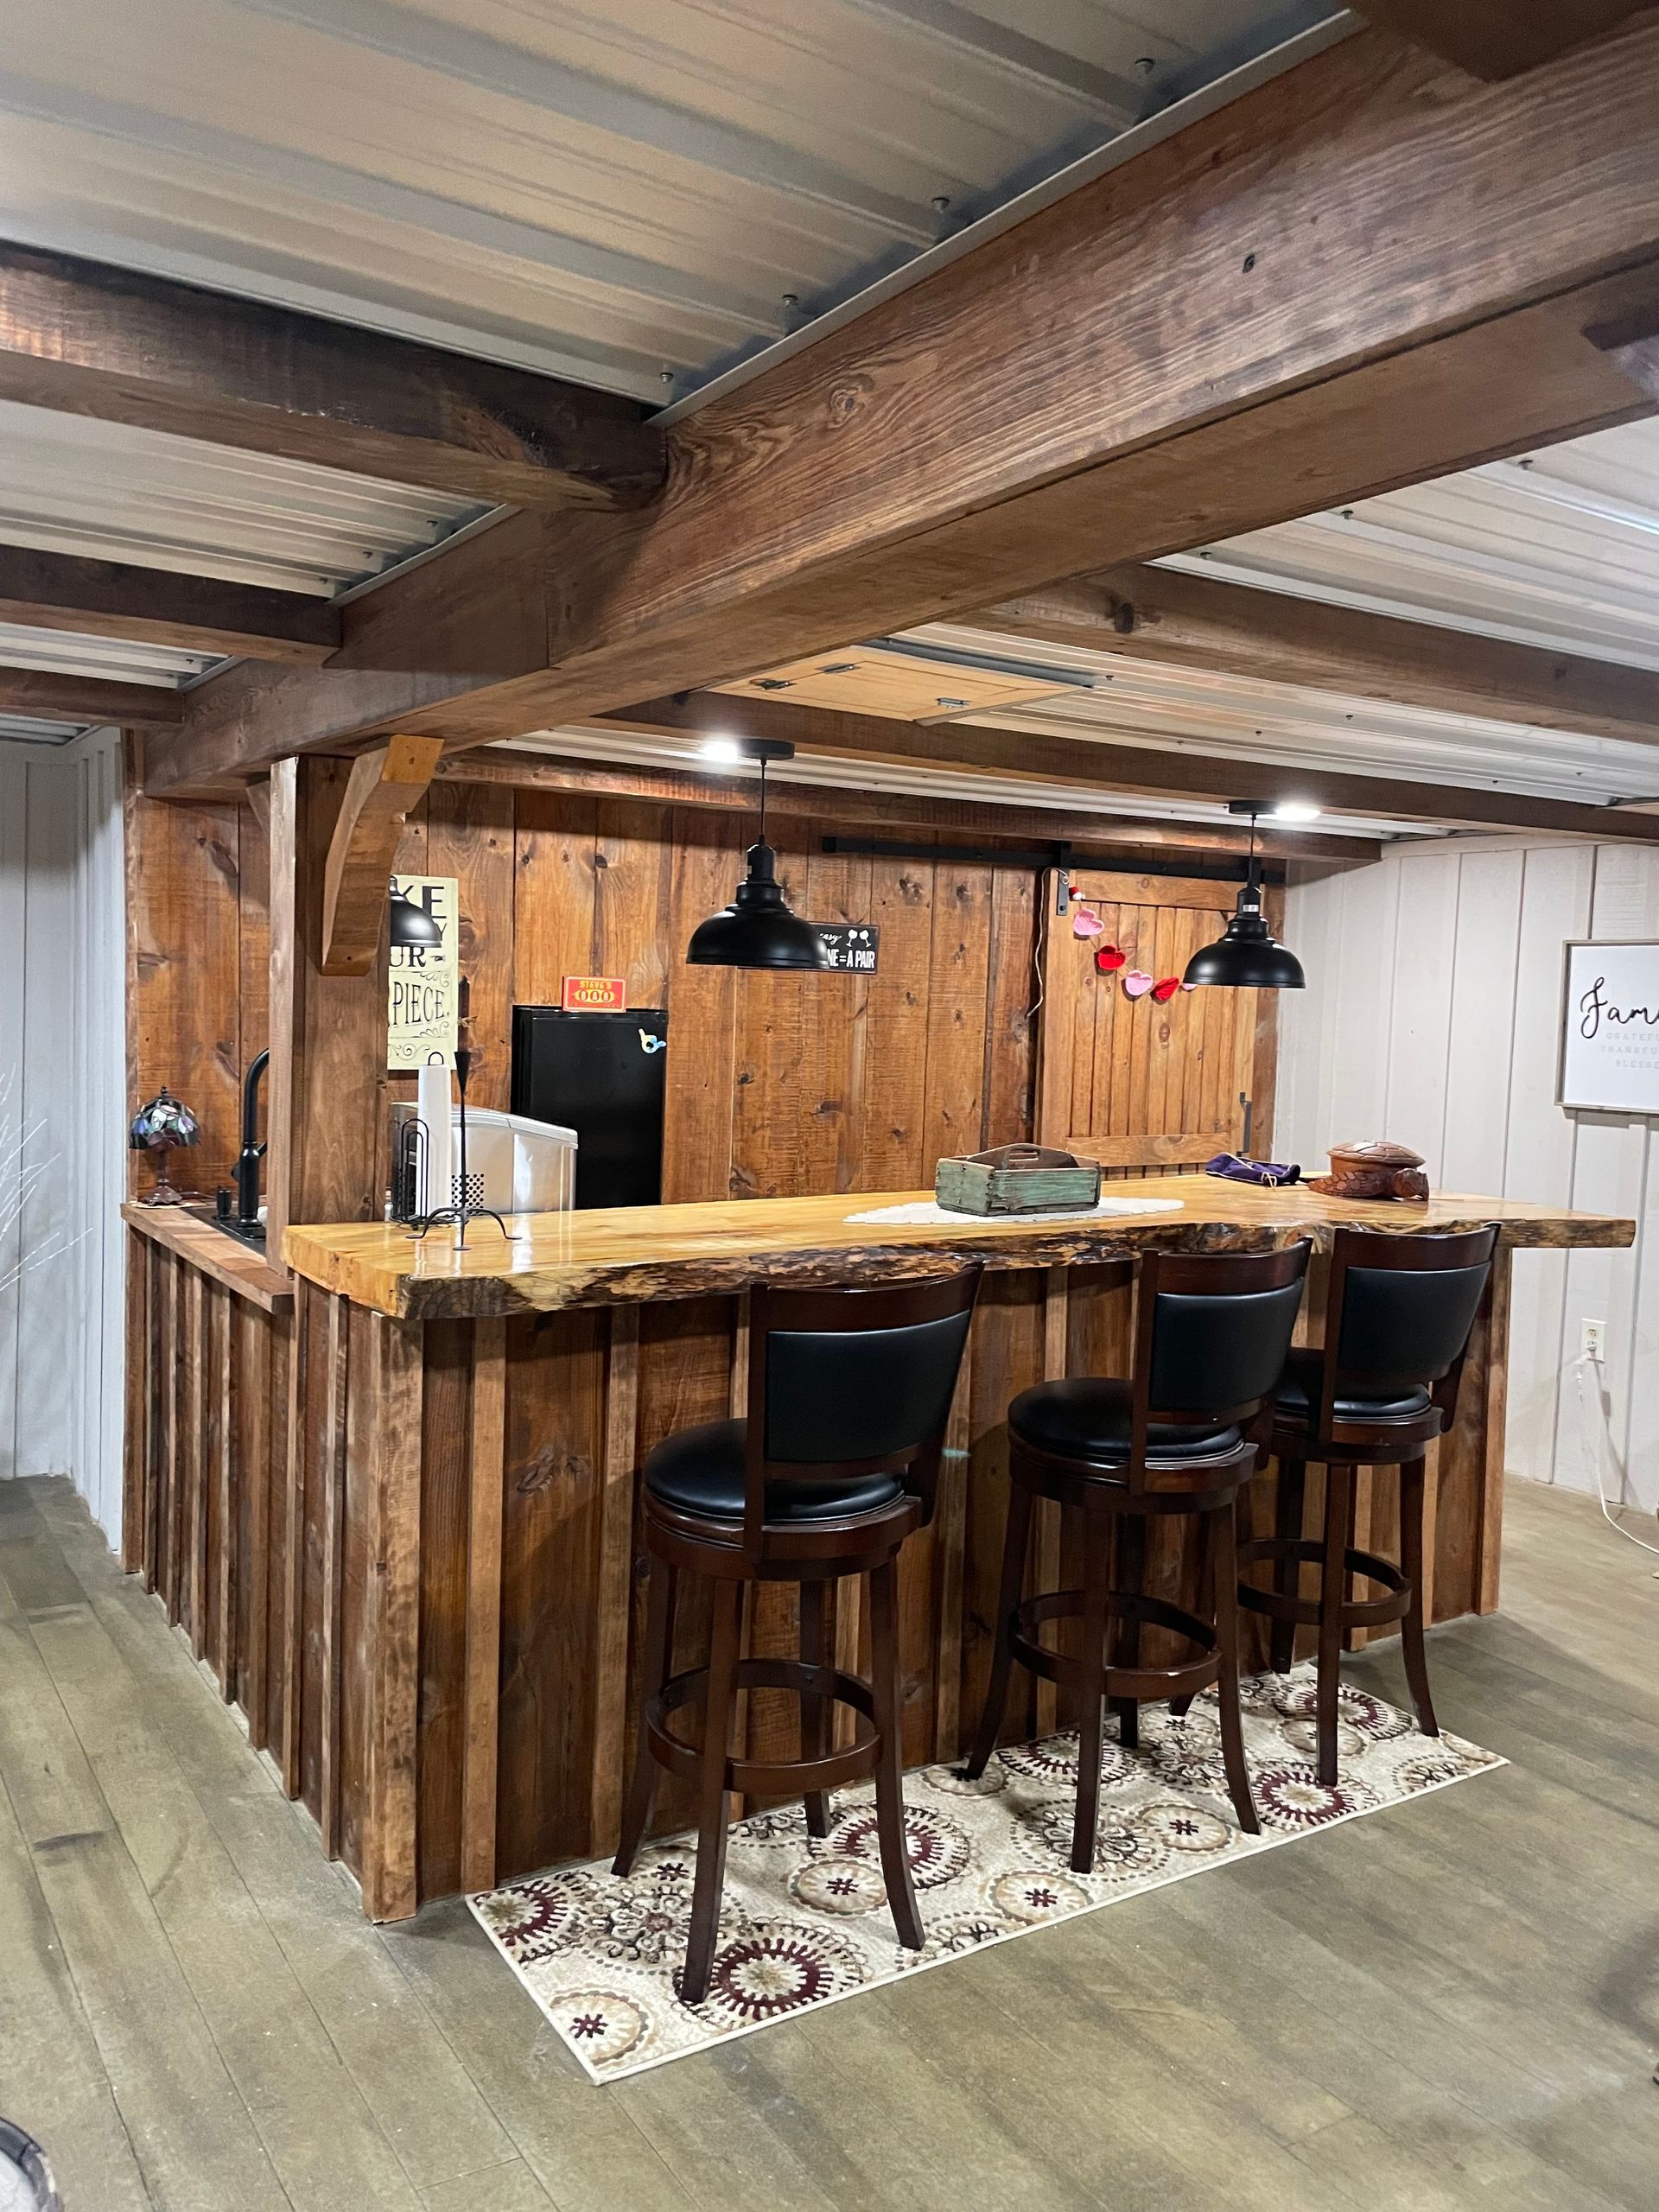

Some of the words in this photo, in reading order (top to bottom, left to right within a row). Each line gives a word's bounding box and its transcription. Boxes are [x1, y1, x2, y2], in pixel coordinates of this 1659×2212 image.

[855, 950, 875, 969] PAIR
[580, 980, 612, 989] STEVE'S
[1580, 976, 1659, 1039] Fam
